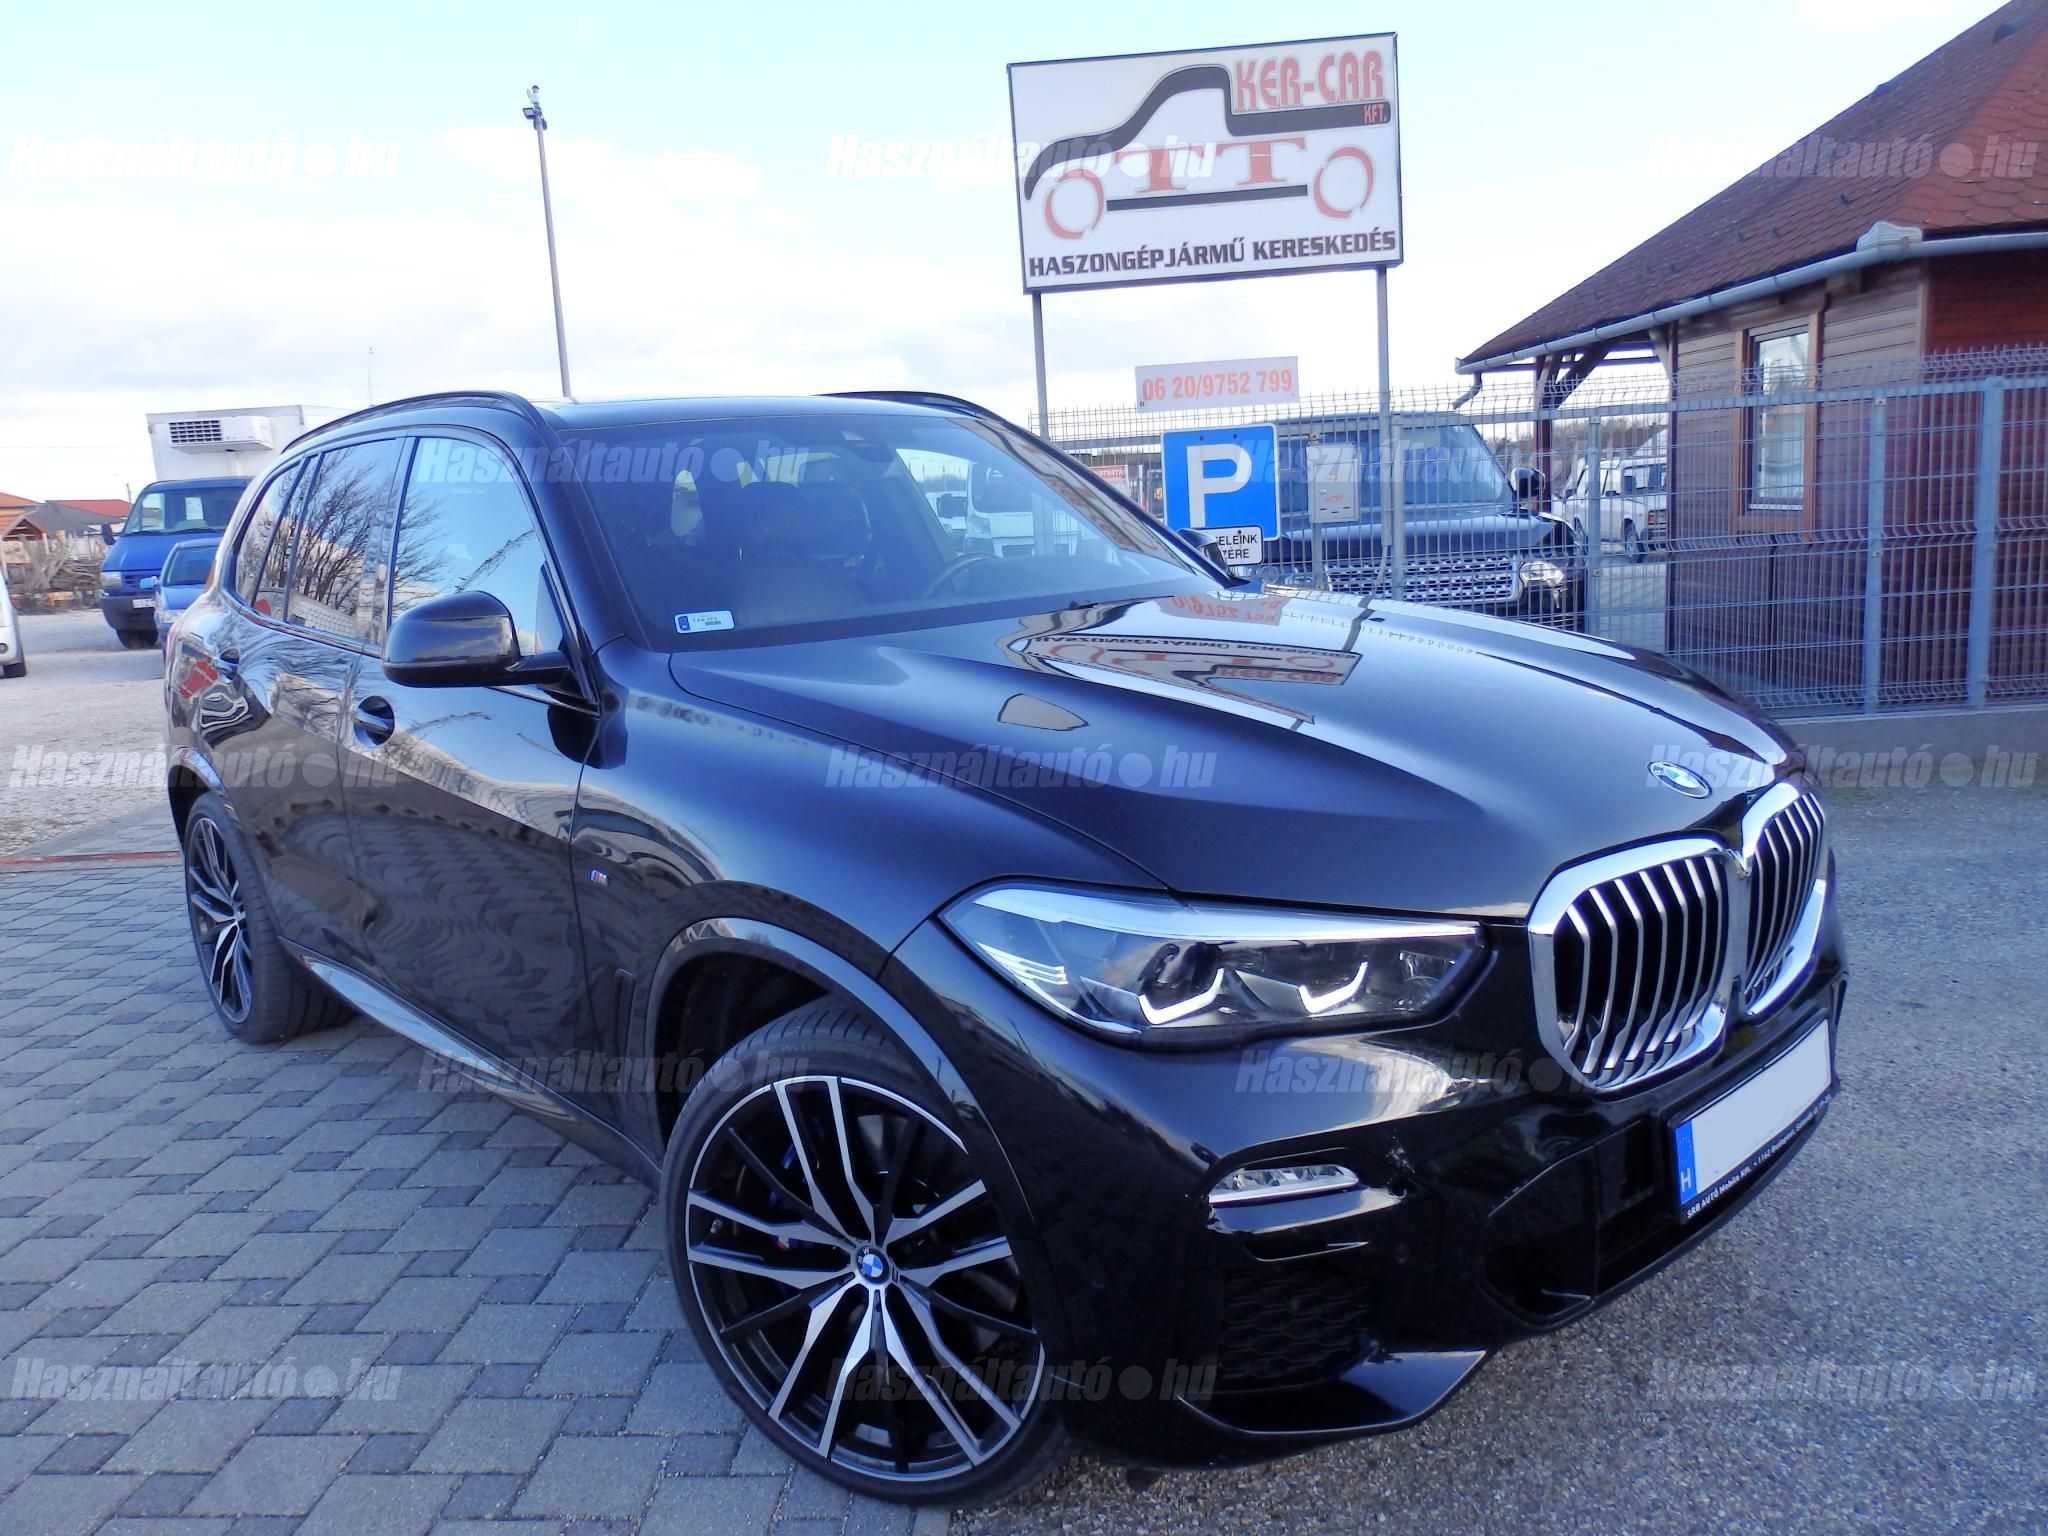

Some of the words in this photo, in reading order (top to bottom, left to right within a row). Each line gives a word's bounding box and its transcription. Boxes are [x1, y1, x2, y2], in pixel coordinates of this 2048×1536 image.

[1236, 50, 1385, 112] KER-CAR
[1363, 105, 1387, 123] KFT.
[1029, 237, 1245, 278] HASZONGÉPJÁRMŰ
[1253, 227, 1396, 261] KERESKEDÉS
[1142, 378, 1165, 400] 06
[1172, 372, 1250, 400] 20/9752
[1256, 369, 1292, 392] 799
[1187, 443, 1252, 528] P
[1216, 534, 1258, 546] ELEINK
[1681, 1167, 1692, 1193] H
